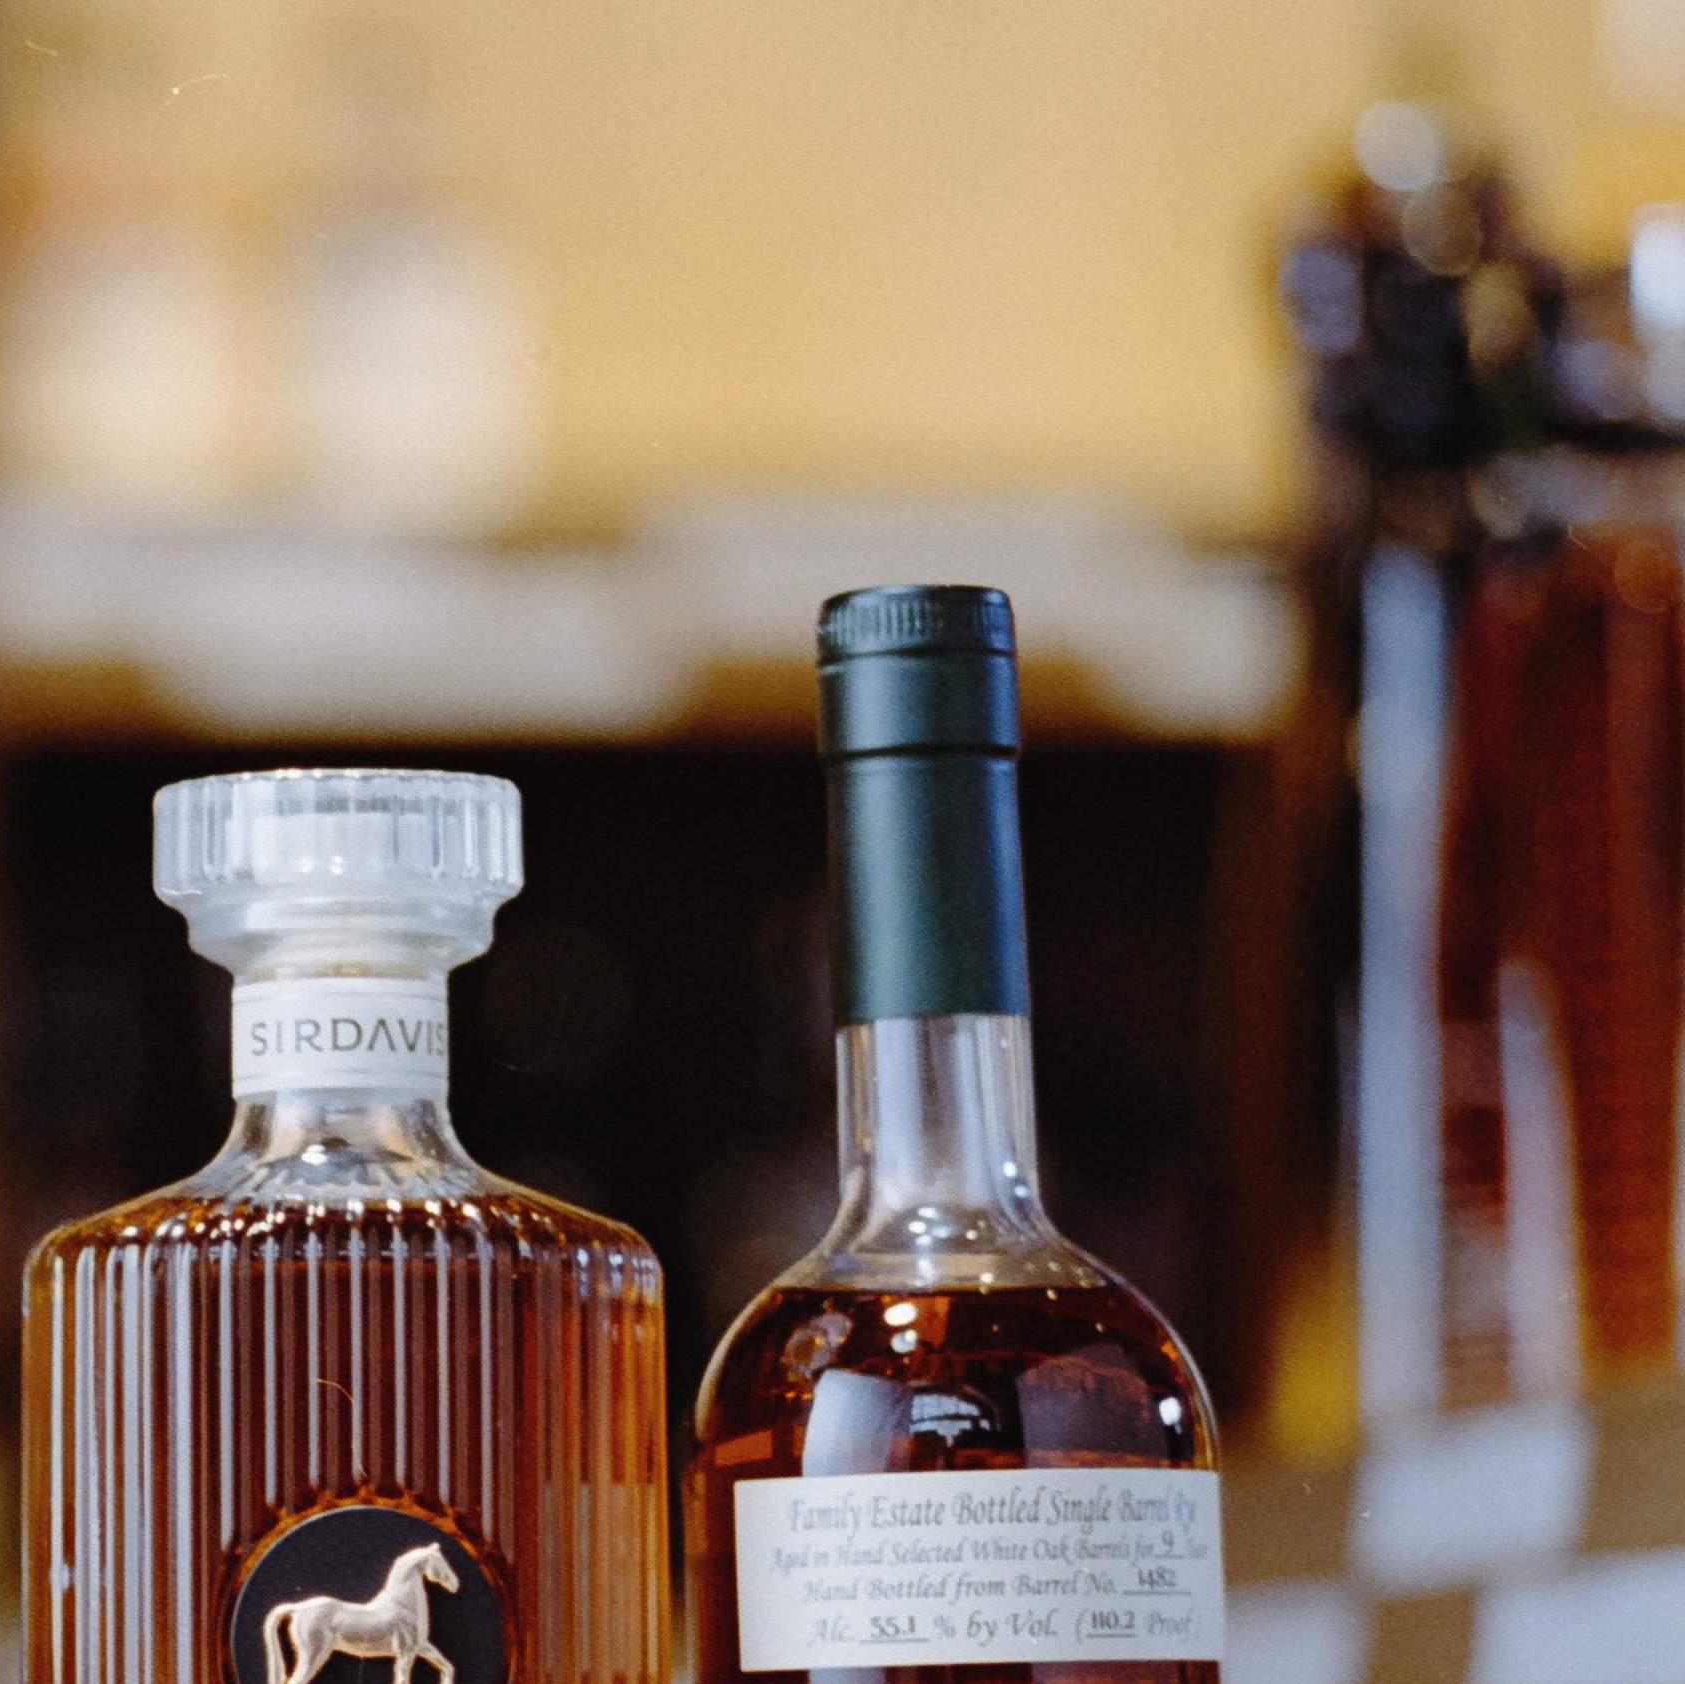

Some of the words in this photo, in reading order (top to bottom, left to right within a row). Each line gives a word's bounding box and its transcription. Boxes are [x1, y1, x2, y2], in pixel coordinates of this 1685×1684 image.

[250, 1017, 446, 1057] SIRDAVIS
[789, 1491, 862, 1541] Family
[869, 1494, 947, 1529] Estate
[952, 1484, 1046, 1526] Bottled
[1046, 1484, 1112, 1536] Single
[834, 1540, 889, 1567] Hand
[888, 1536, 969, 1567] Selected
[971, 1533, 1029, 1561] White
[1033, 1534, 1074, 1566] Oak
[802, 1575, 864, 1604] Hand
[865, 1572, 954, 1601] Bottled
[948, 1571, 1006, 1606] from
[1011, 1569, 1083, 1596] Barrel
[807, 1614, 856, 1648] Alc.
[869, 1614, 917, 1639] 55.1
[933, 1613, 957, 1639] %
[966, 1609, 998, 1649] by
